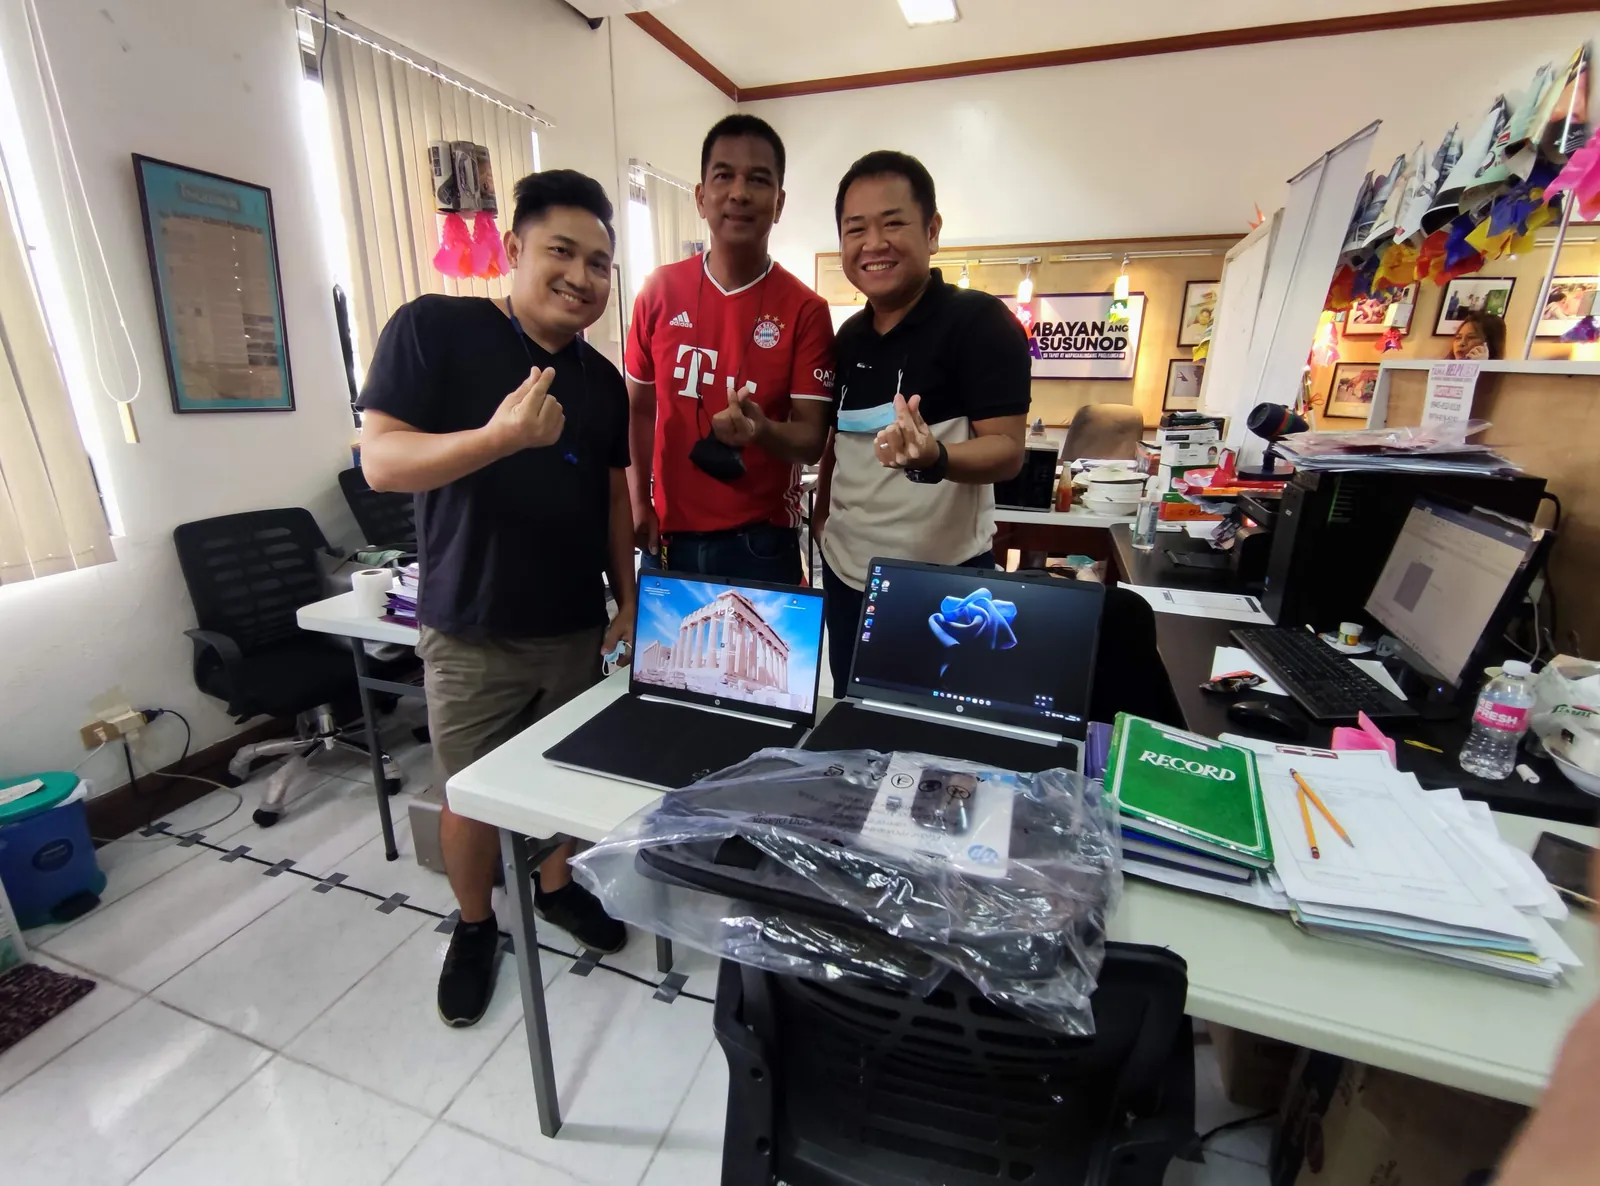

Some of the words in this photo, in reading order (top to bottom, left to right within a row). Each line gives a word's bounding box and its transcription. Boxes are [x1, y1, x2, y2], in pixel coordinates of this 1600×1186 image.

[1107, 324, 1129, 332] ANG
[1477, 706, 1518, 725] FRESH
[1138, 750, 1236, 781] RECORD
